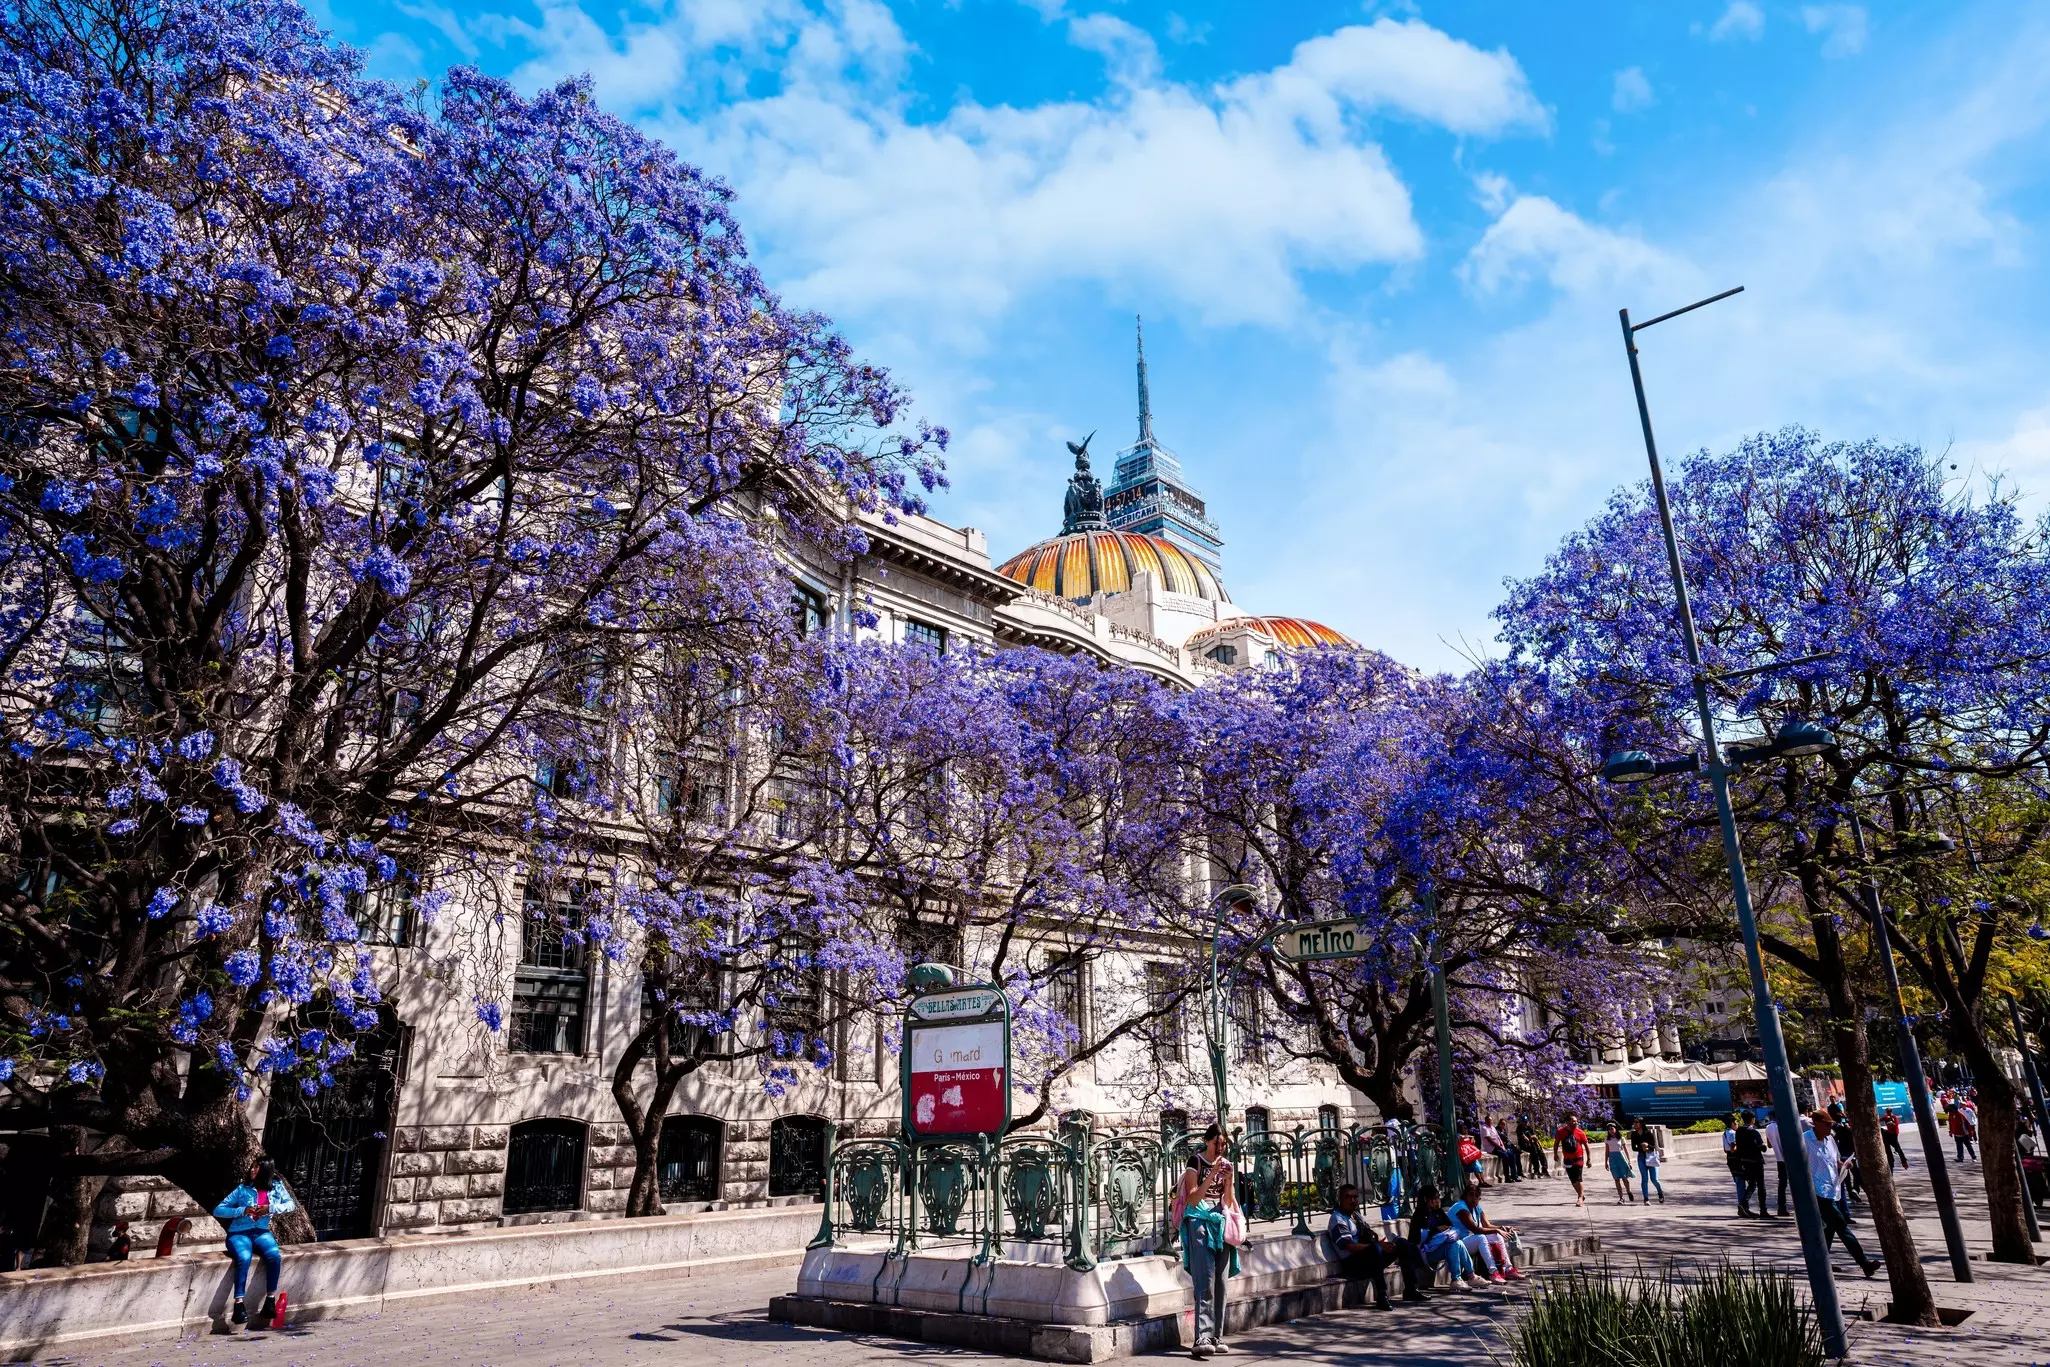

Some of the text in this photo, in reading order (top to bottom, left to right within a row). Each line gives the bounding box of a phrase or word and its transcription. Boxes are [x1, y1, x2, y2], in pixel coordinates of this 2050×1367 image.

[1300, 927, 1354, 954] METRO
[928, 999, 955, 1014] BELLAS
[956, 996, 981, 1011] ARTES
[934, 1045, 981, 1063] Gmard
